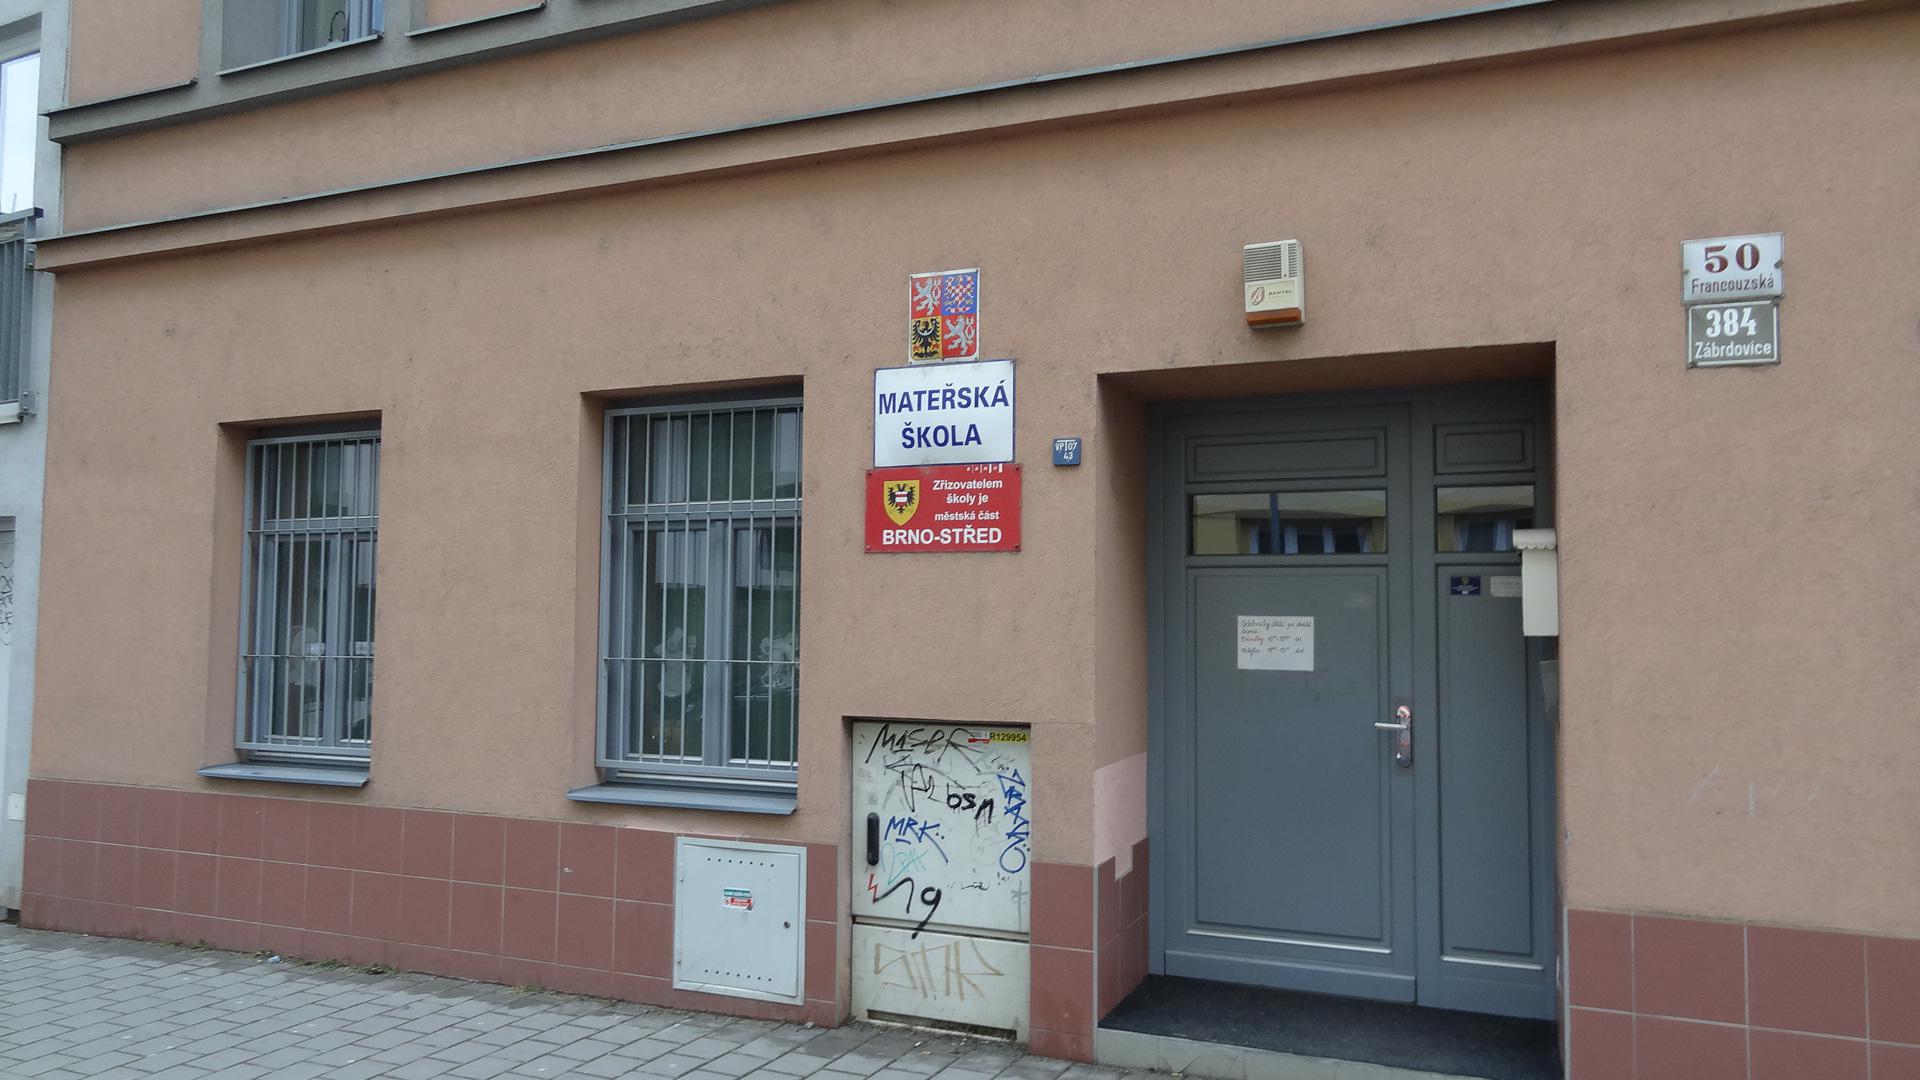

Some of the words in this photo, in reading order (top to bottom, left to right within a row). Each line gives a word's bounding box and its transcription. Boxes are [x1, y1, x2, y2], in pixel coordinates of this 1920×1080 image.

[1704, 243, 1760, 273] 50
[1691, 273, 1774, 294] Francouzská
[1706, 307, 1757, 338] 384
[1695, 340, 1772, 359] Zábrdovice
[878, 379, 1010, 415] MATEŘSKÁ
[901, 422, 982, 449] ŠKOLA
[1063, 451, 1074, 461] 43
[933, 478, 1003, 491] Zřizovatelem
[946, 493, 975, 506] školy
[978, 493, 989, 507] je
[934, 510, 976, 522] městská
[977, 509, 1000, 521] část
[881, 525, 1002, 545] BRNO-STŘED
